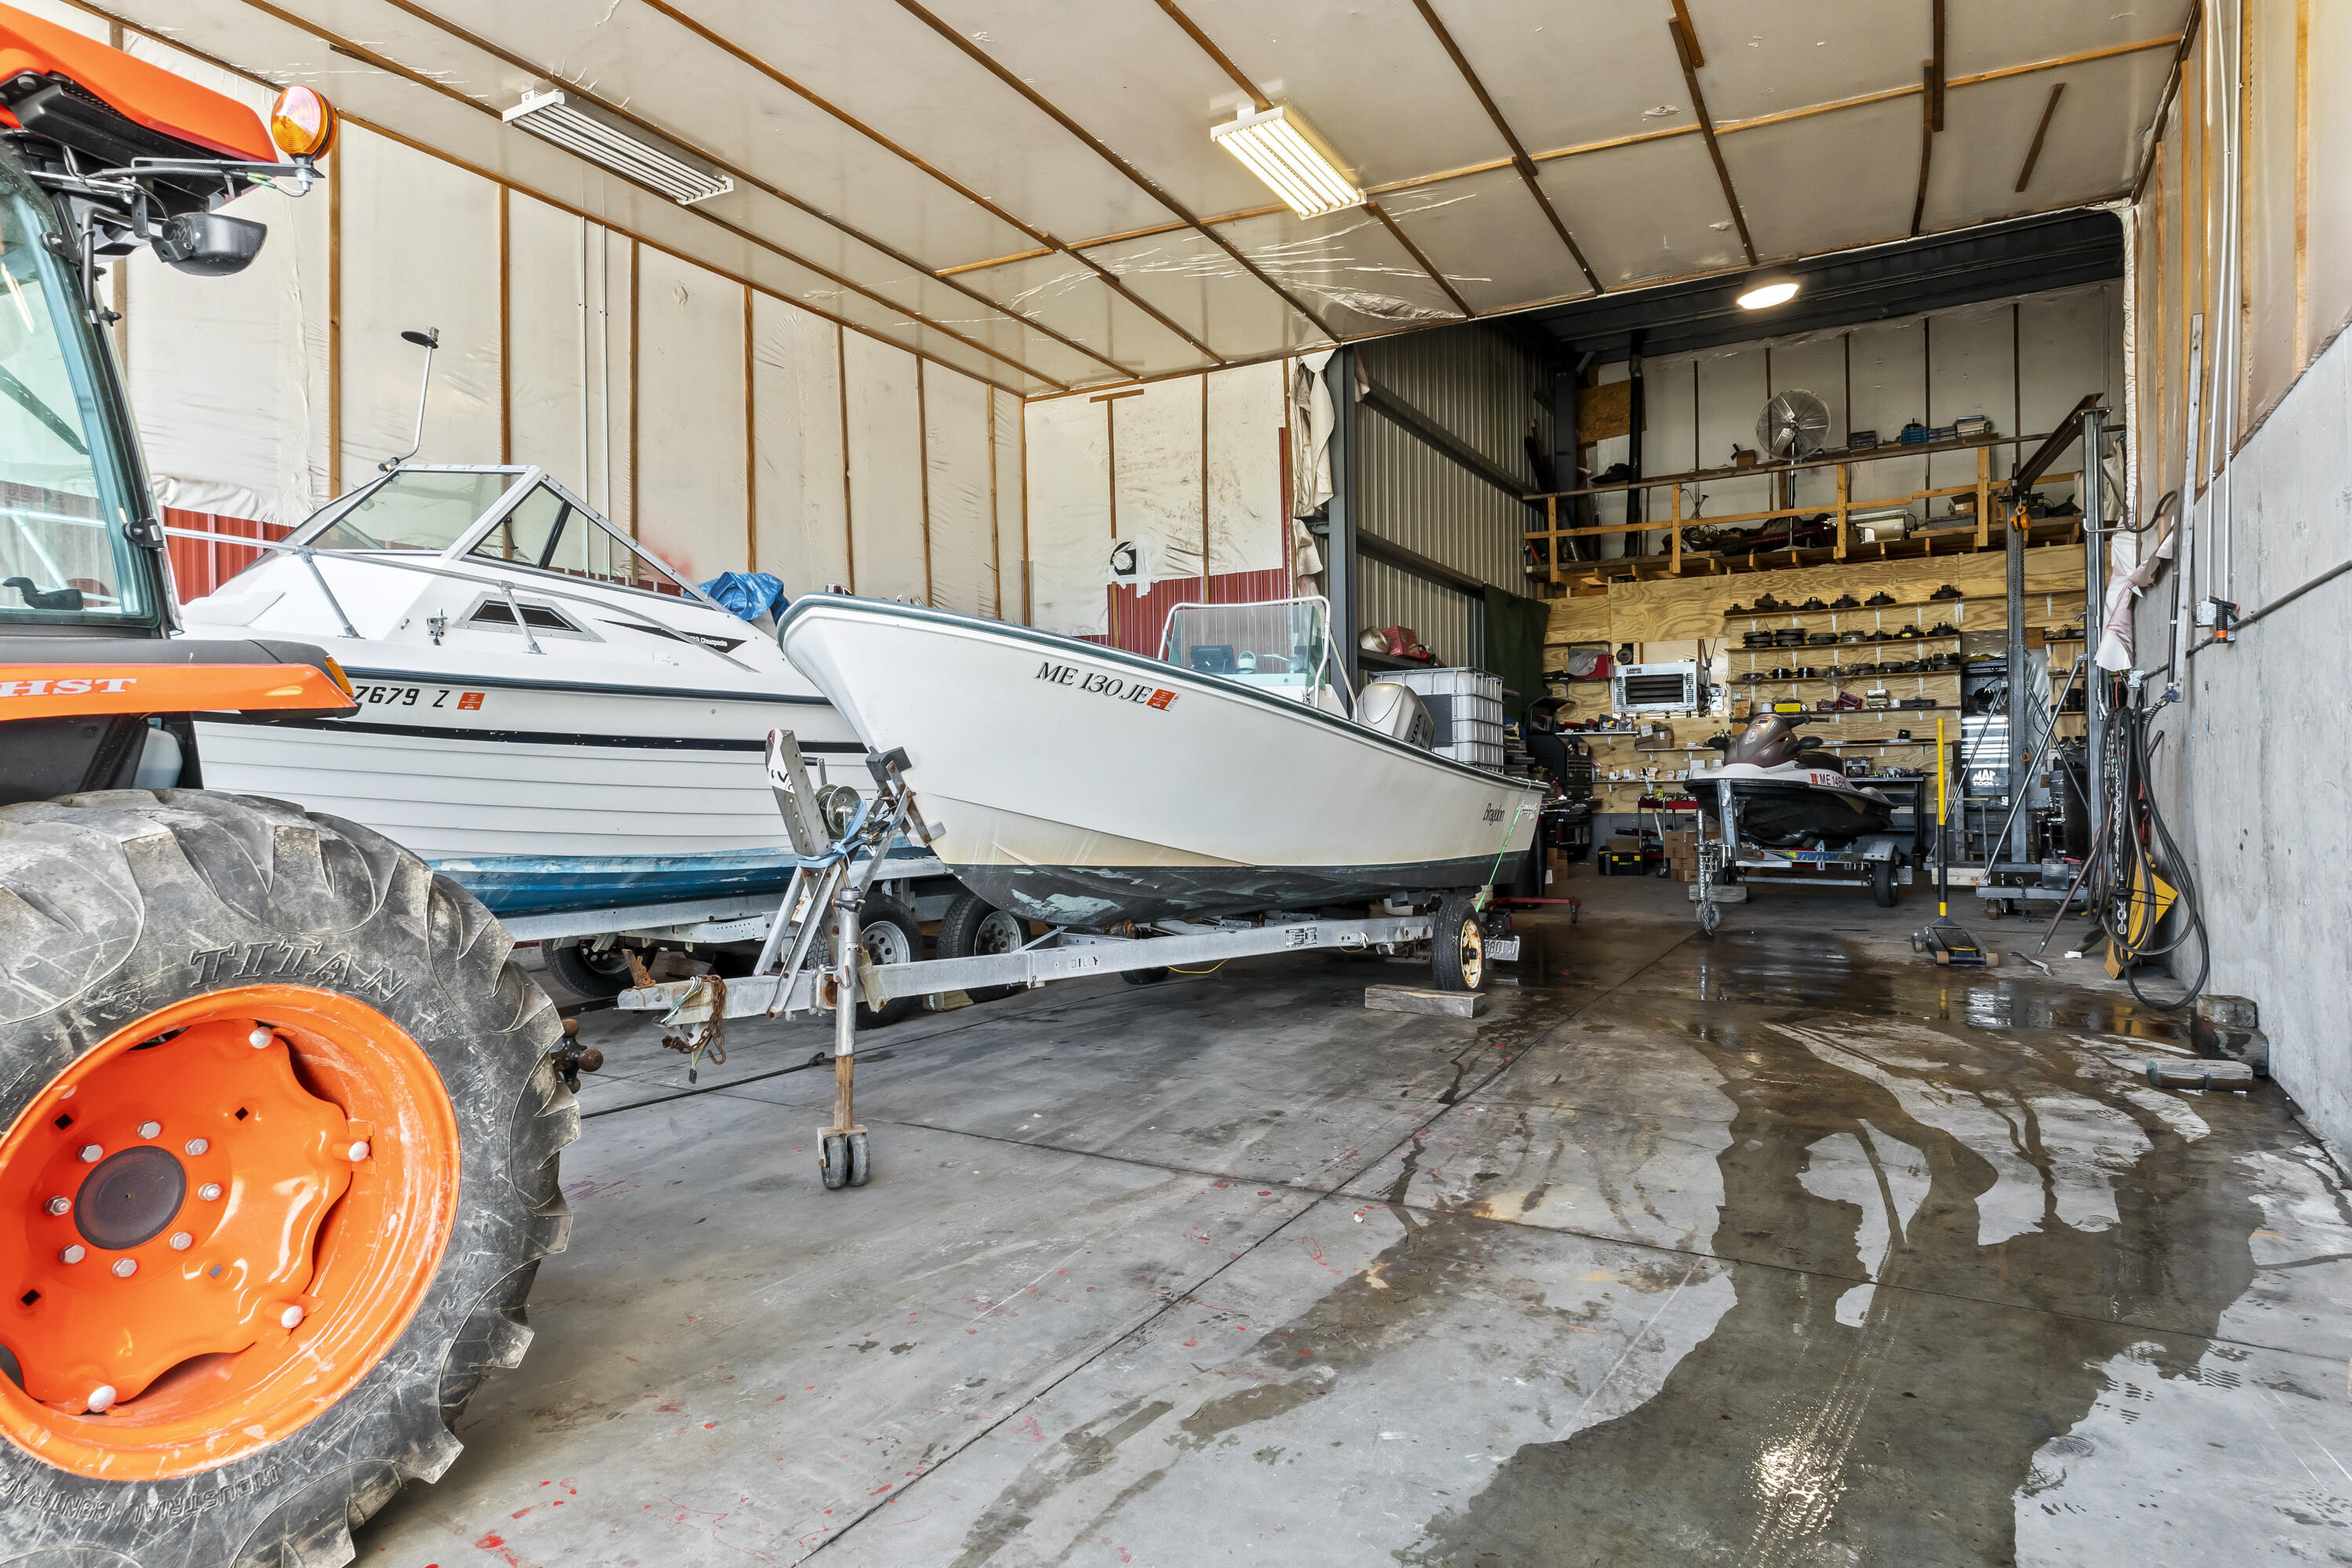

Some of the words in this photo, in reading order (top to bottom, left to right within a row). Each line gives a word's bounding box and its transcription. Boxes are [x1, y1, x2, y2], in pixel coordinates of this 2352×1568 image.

[0, 678, 137, 697] HST
[1034, 662, 1078, 686] ME
[1077, 673, 1123, 696] 130
[1119, 684, 1153, 704] JE
[354, 685, 420, 706] 7679
[433, 690, 450, 708] Z
[1819, 773, 1831, 786] ME
[1796, 851, 1838, 861] TRITON
[189, 940, 409, 1004] TITAN
